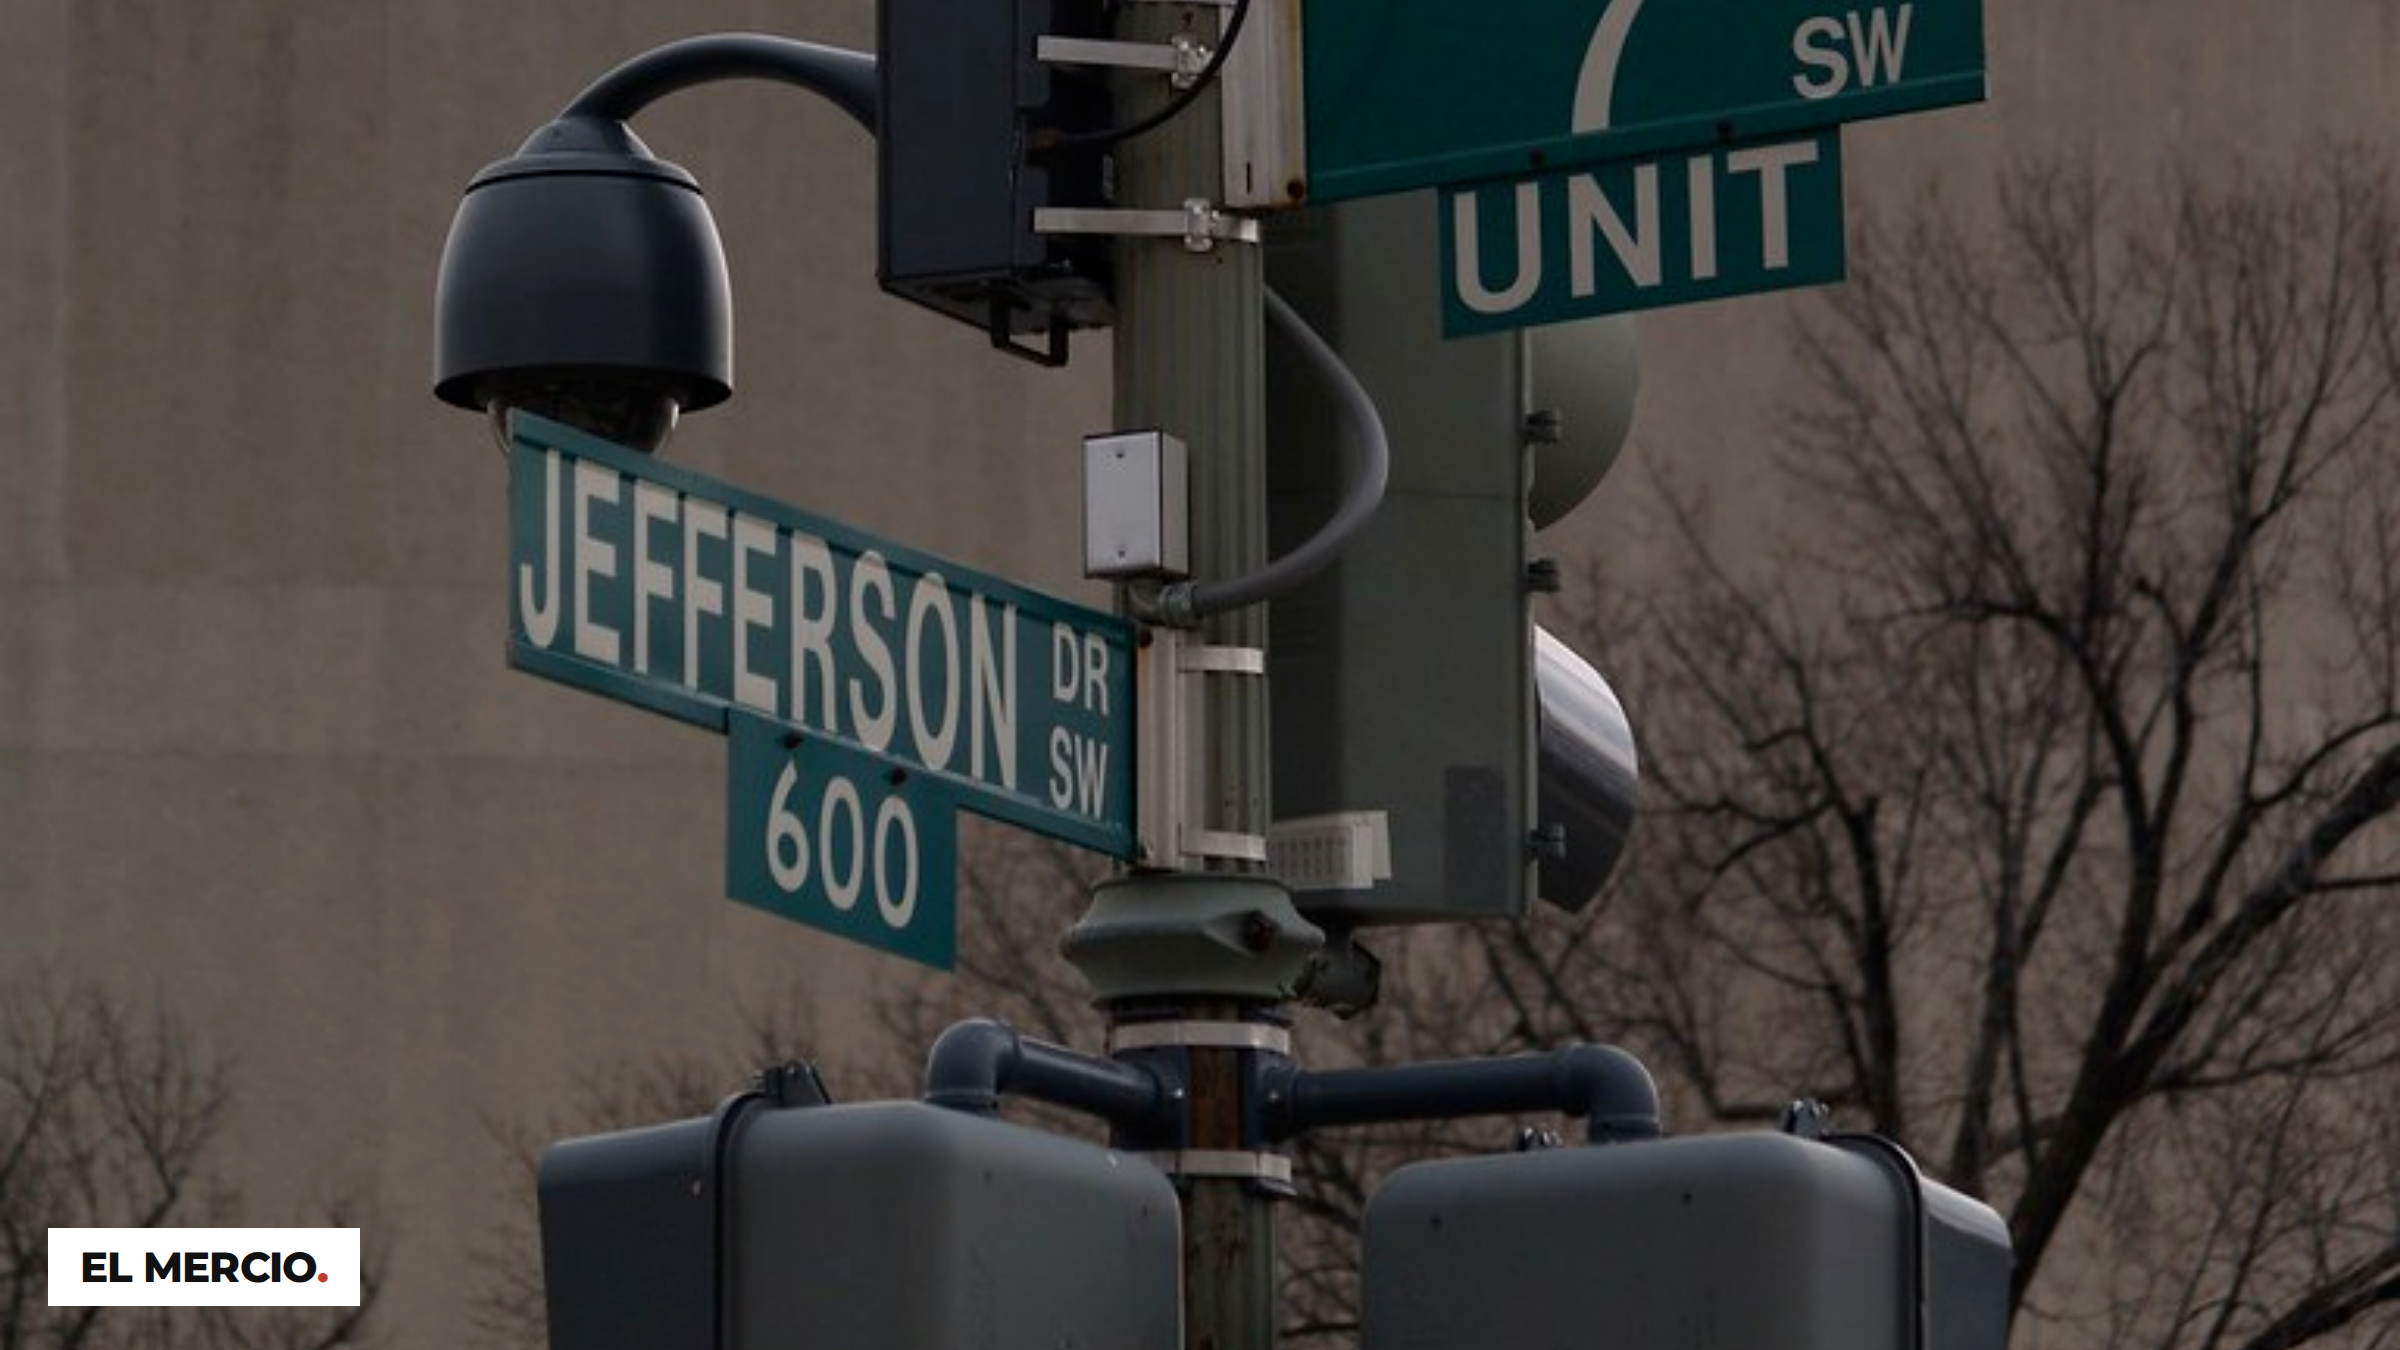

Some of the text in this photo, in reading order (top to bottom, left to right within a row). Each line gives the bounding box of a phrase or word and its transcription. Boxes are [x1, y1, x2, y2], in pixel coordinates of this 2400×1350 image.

[1792, 3, 1913, 100] SW
[1453, 138, 1820, 315] UNIT
[519, 448, 1110, 792] JEFFERSON DR
[766, 760, 921, 929] 600
[1049, 724, 1109, 821] SW
